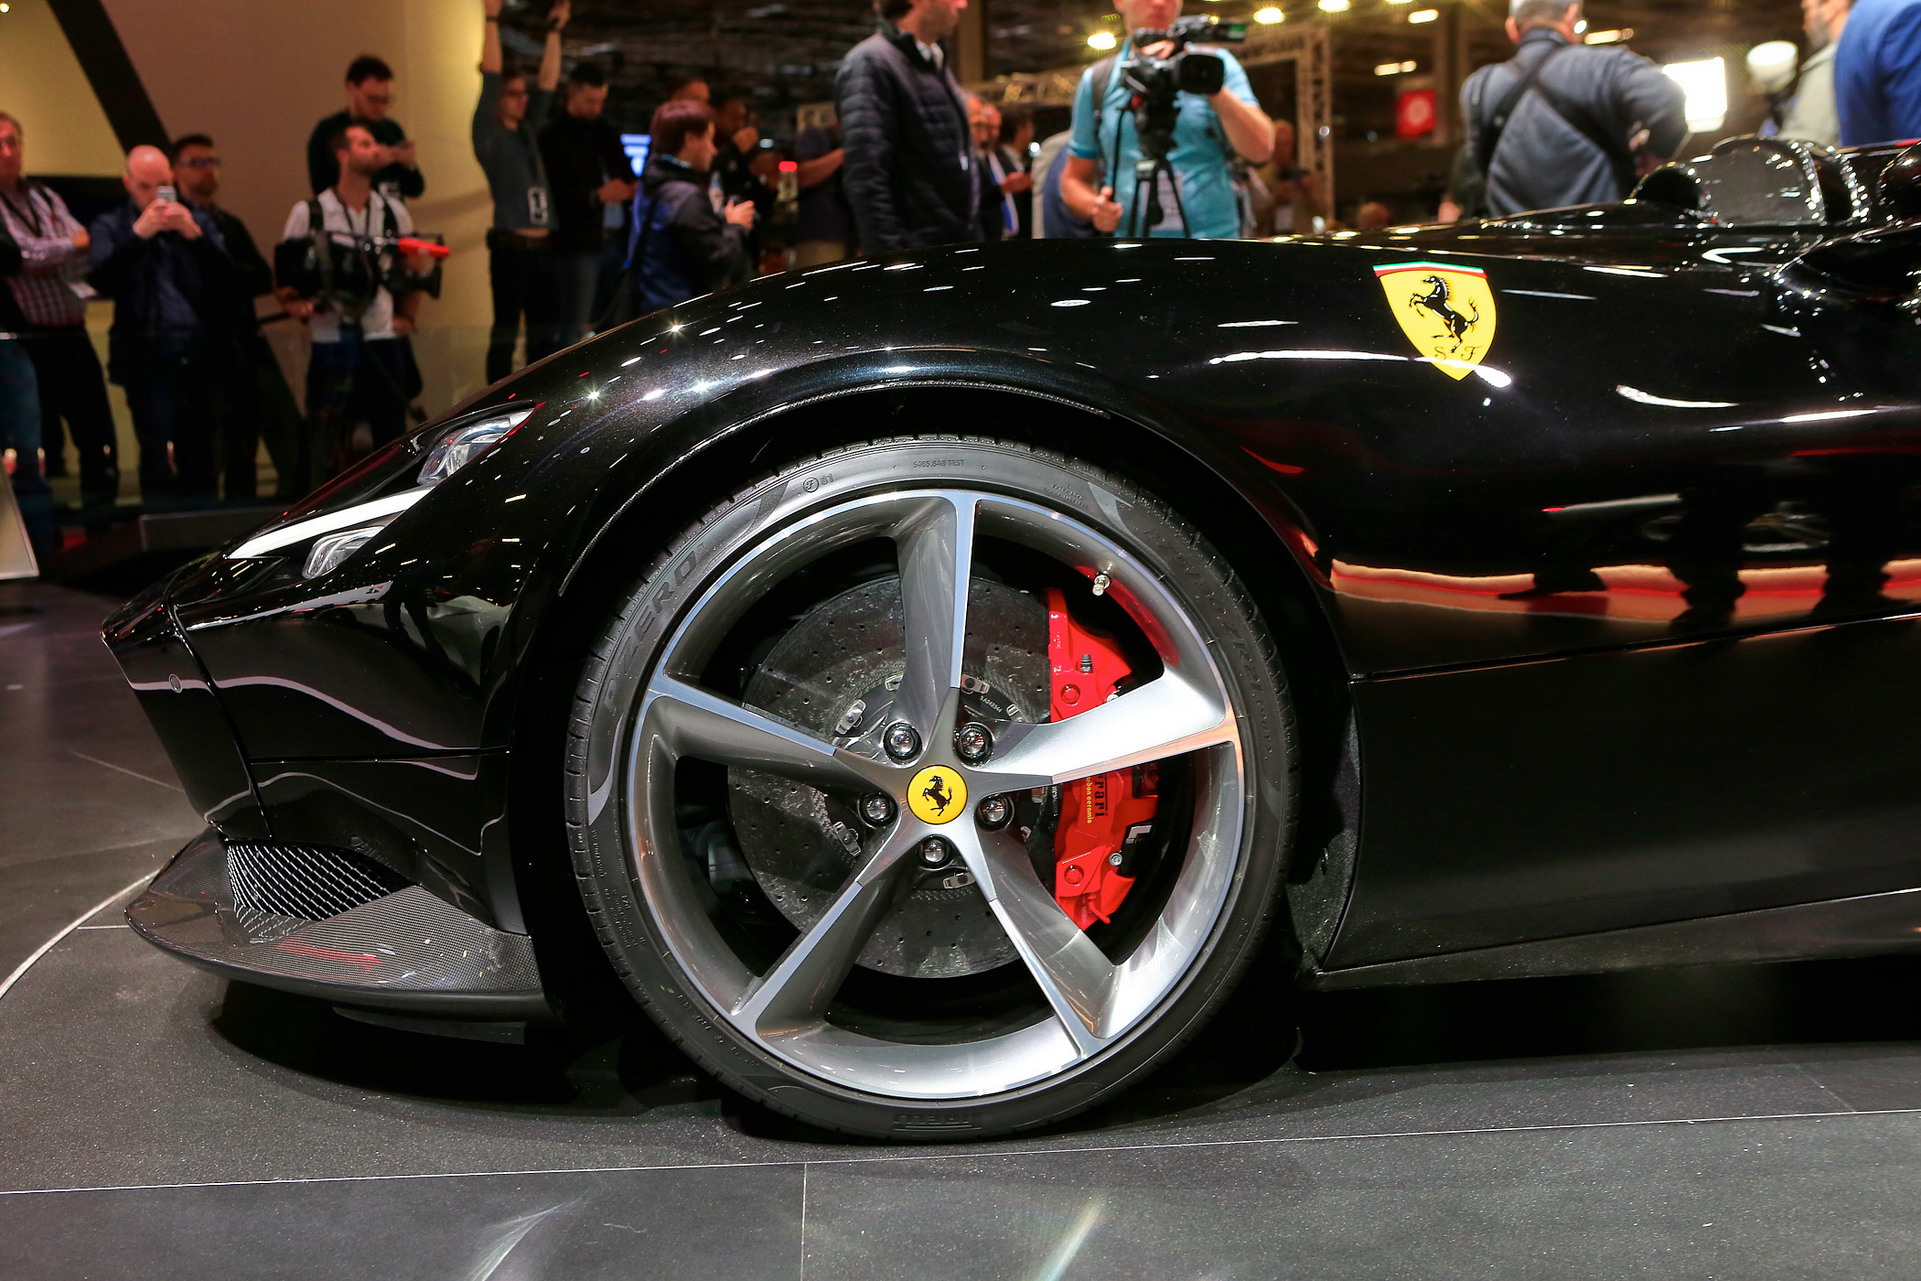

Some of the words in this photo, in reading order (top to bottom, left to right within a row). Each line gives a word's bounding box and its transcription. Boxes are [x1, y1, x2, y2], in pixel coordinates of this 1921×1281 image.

[1434, 345, 1447, 361] S
[617, 550, 698, 676] ZERO
[1094, 774, 1108, 816] rari
